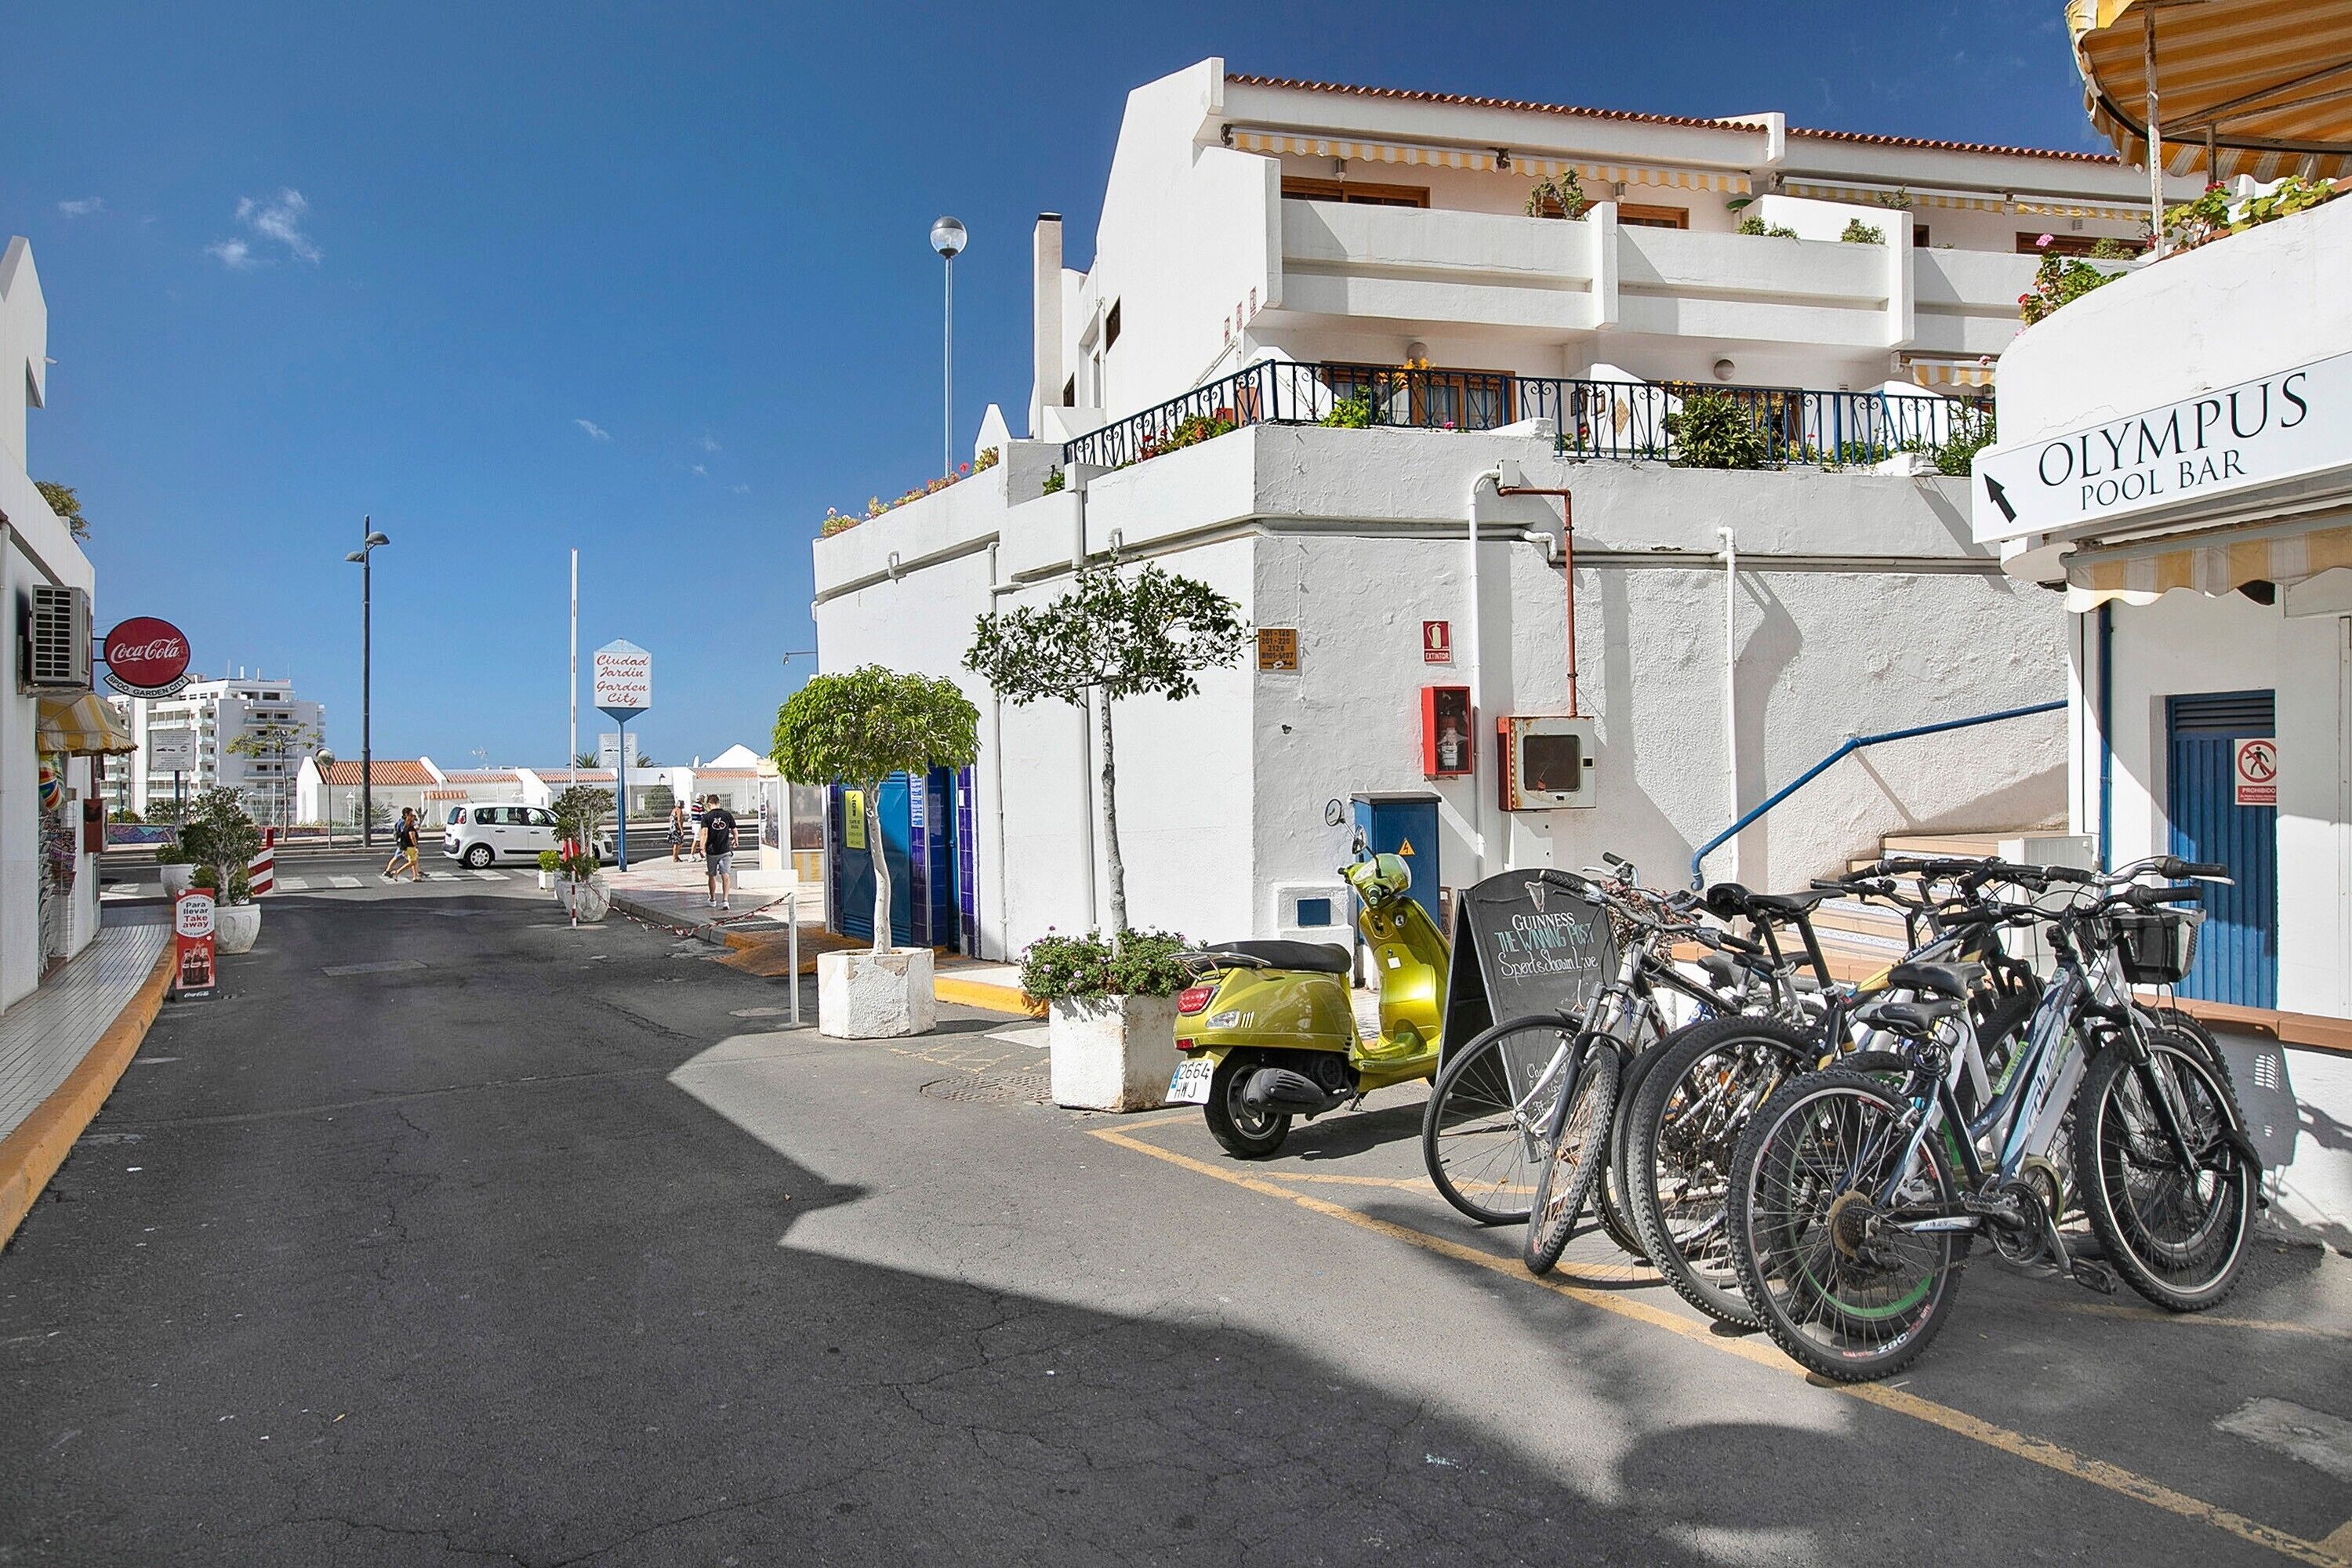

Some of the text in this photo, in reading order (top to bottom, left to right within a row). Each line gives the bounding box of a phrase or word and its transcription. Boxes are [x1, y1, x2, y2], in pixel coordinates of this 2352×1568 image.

[2038, 371, 2308, 488] OLYMPUS
[2081, 448, 2248, 511] POOL BAR
[111, 638, 181, 664] Coca-Cola
[597, 655, 648, 666] Ciudad
[132, 688, 169, 697] GARDEN
[169, 677, 186, 690] CITY
[597, 681, 648, 692] Garden
[607, 693, 639, 706] City
[1512, 912, 1576, 931] GUINNESS
[1494, 930, 1519, 953] THE
[1497, 950, 1546, 986] Sports
[1178, 1062, 1209, 1080] 2664
